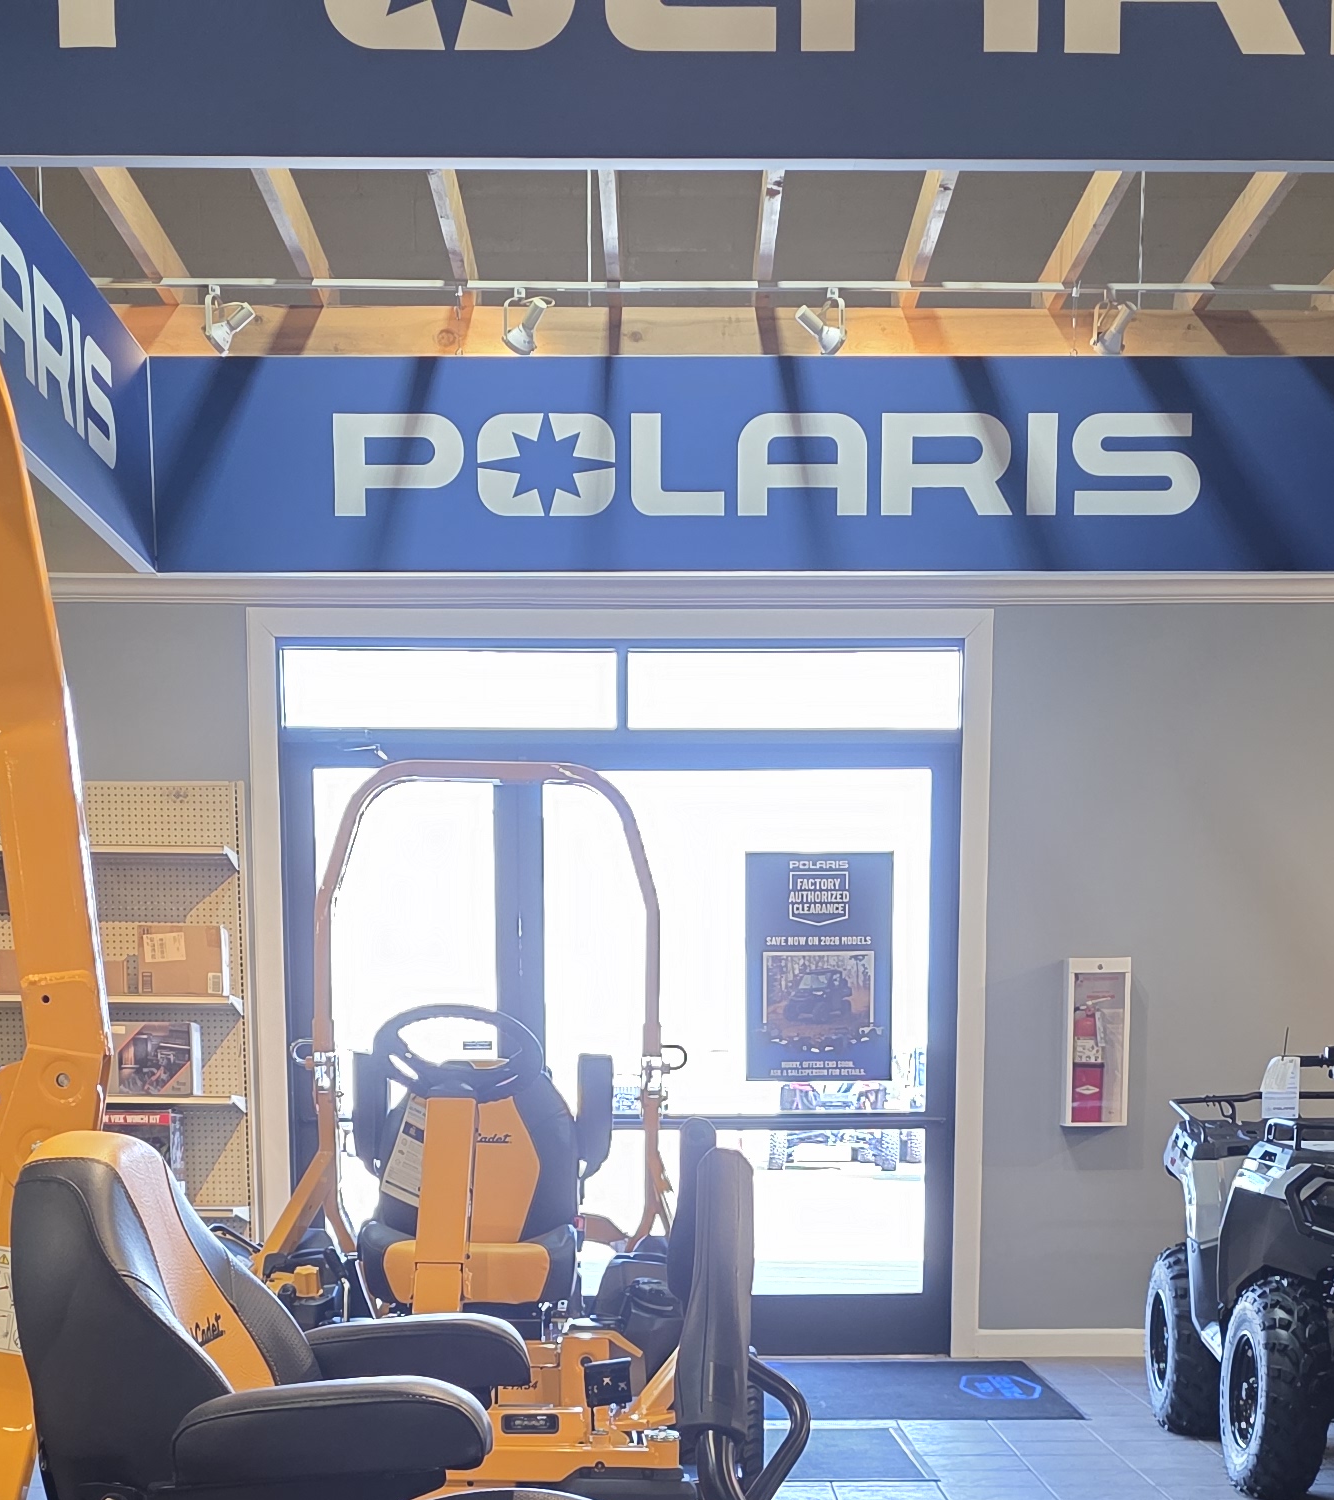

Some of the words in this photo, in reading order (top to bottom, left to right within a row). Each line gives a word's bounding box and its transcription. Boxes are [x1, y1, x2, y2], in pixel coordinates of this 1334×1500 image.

[332, 412, 1201, 517] POLARIS
[789, 860, 849, 869] POLARIS
[797, 878, 841, 890] FACTORY
[789, 891, 850, 903] AUTHORIZED
[793, 904, 845, 914] CLEARANCE
[766, 936, 786, 946] SAVE
[788, 936, 806, 946] NOW
[808, 936, 819, 946] ON
[841, 936, 872, 946] MODELS
